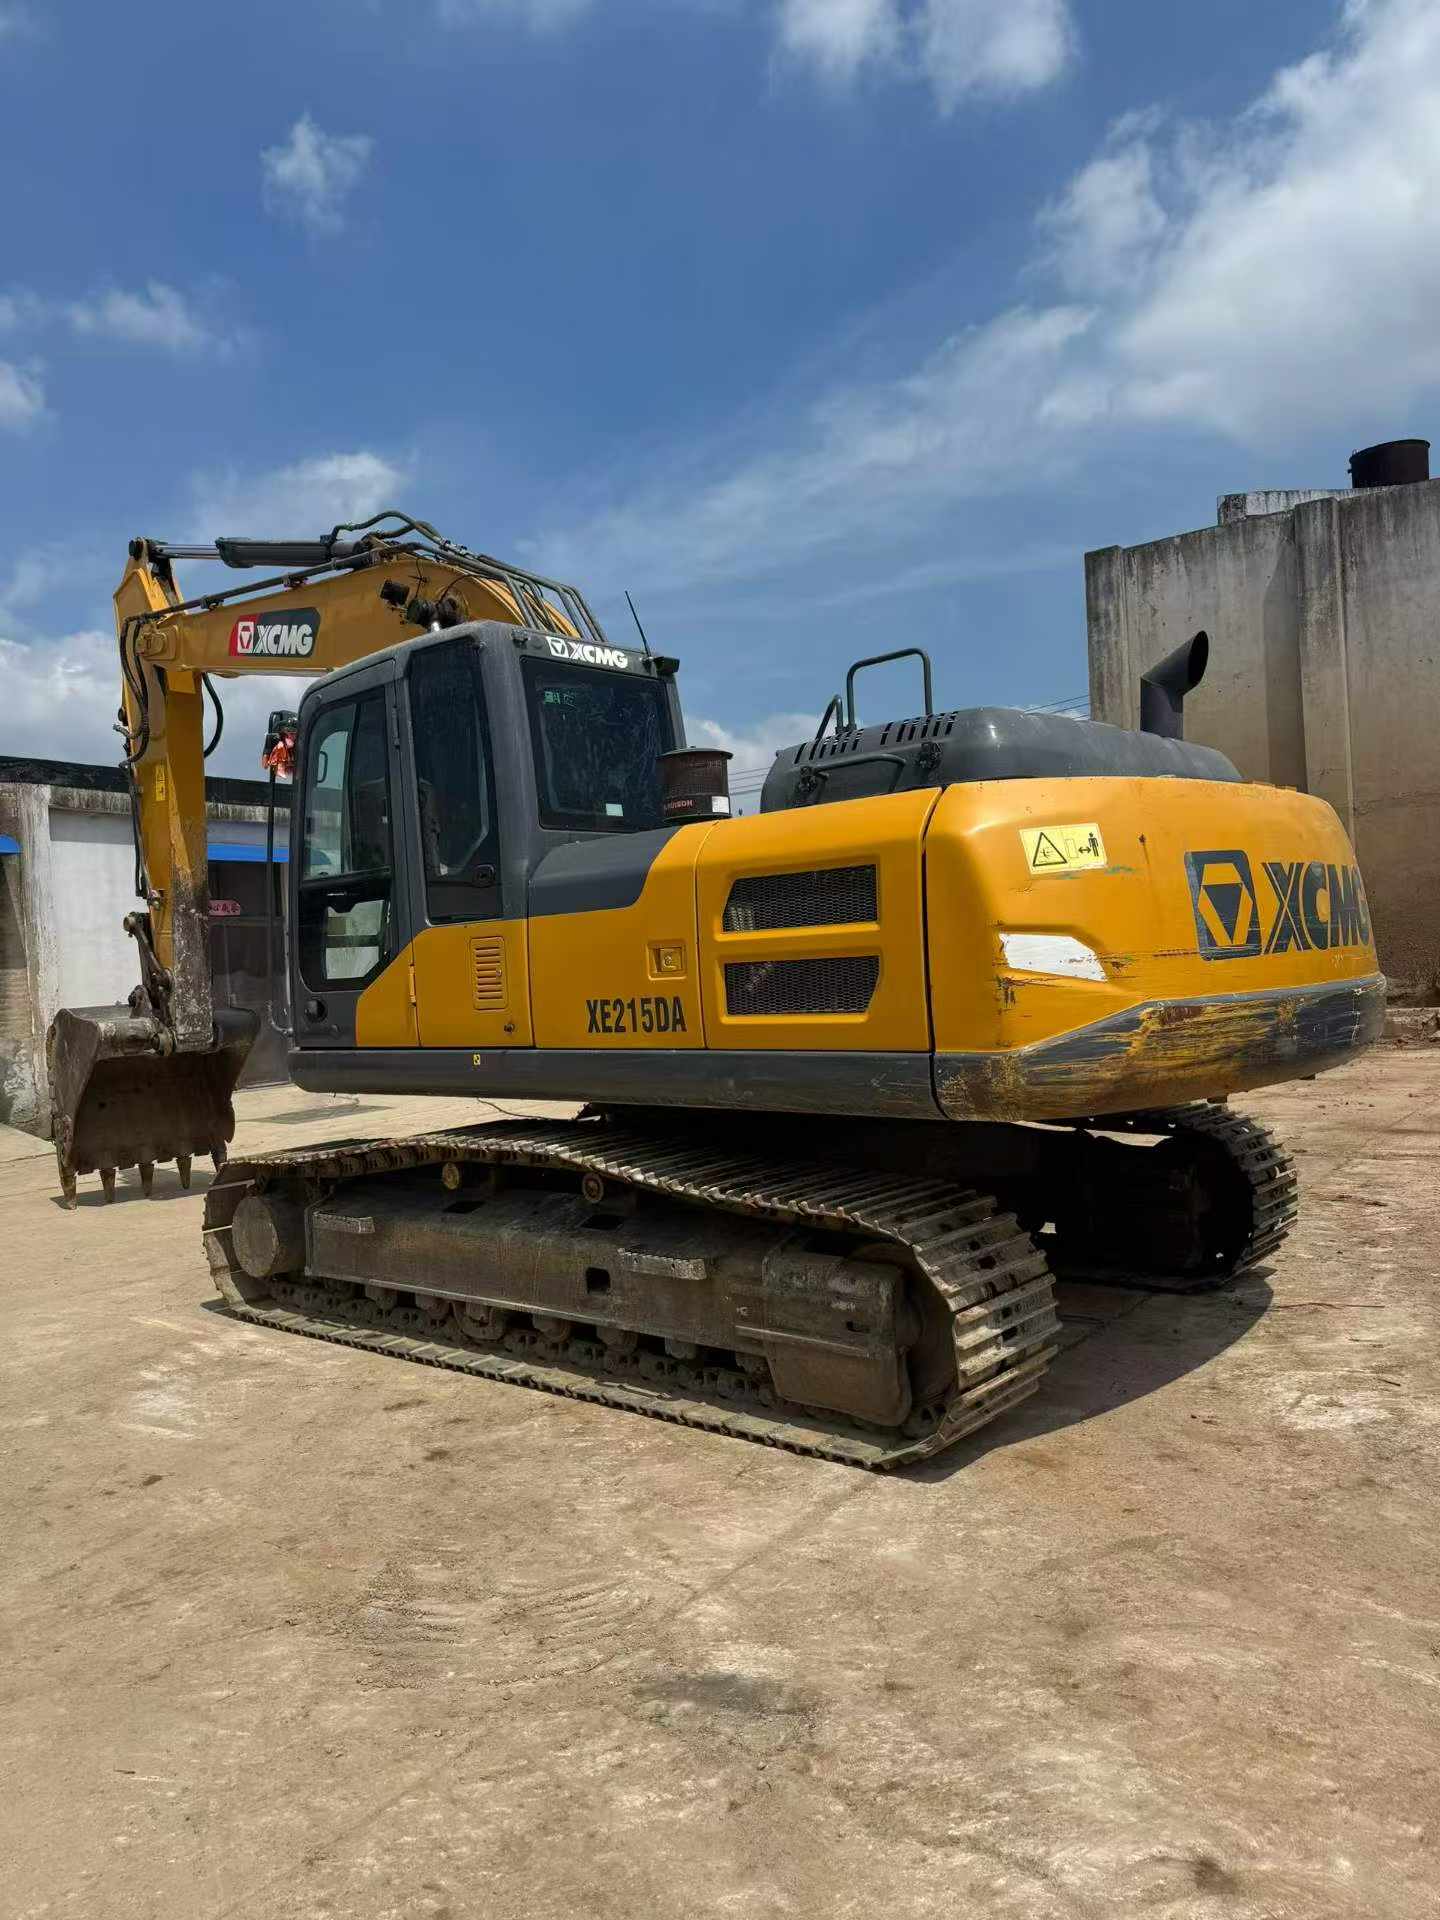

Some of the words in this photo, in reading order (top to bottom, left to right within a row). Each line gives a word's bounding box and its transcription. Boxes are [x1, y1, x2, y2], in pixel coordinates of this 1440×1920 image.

[253, 624, 313, 655] XCMG
[568, 641, 628, 668] XCMG
[585, 996, 688, 1034] XE215DA
